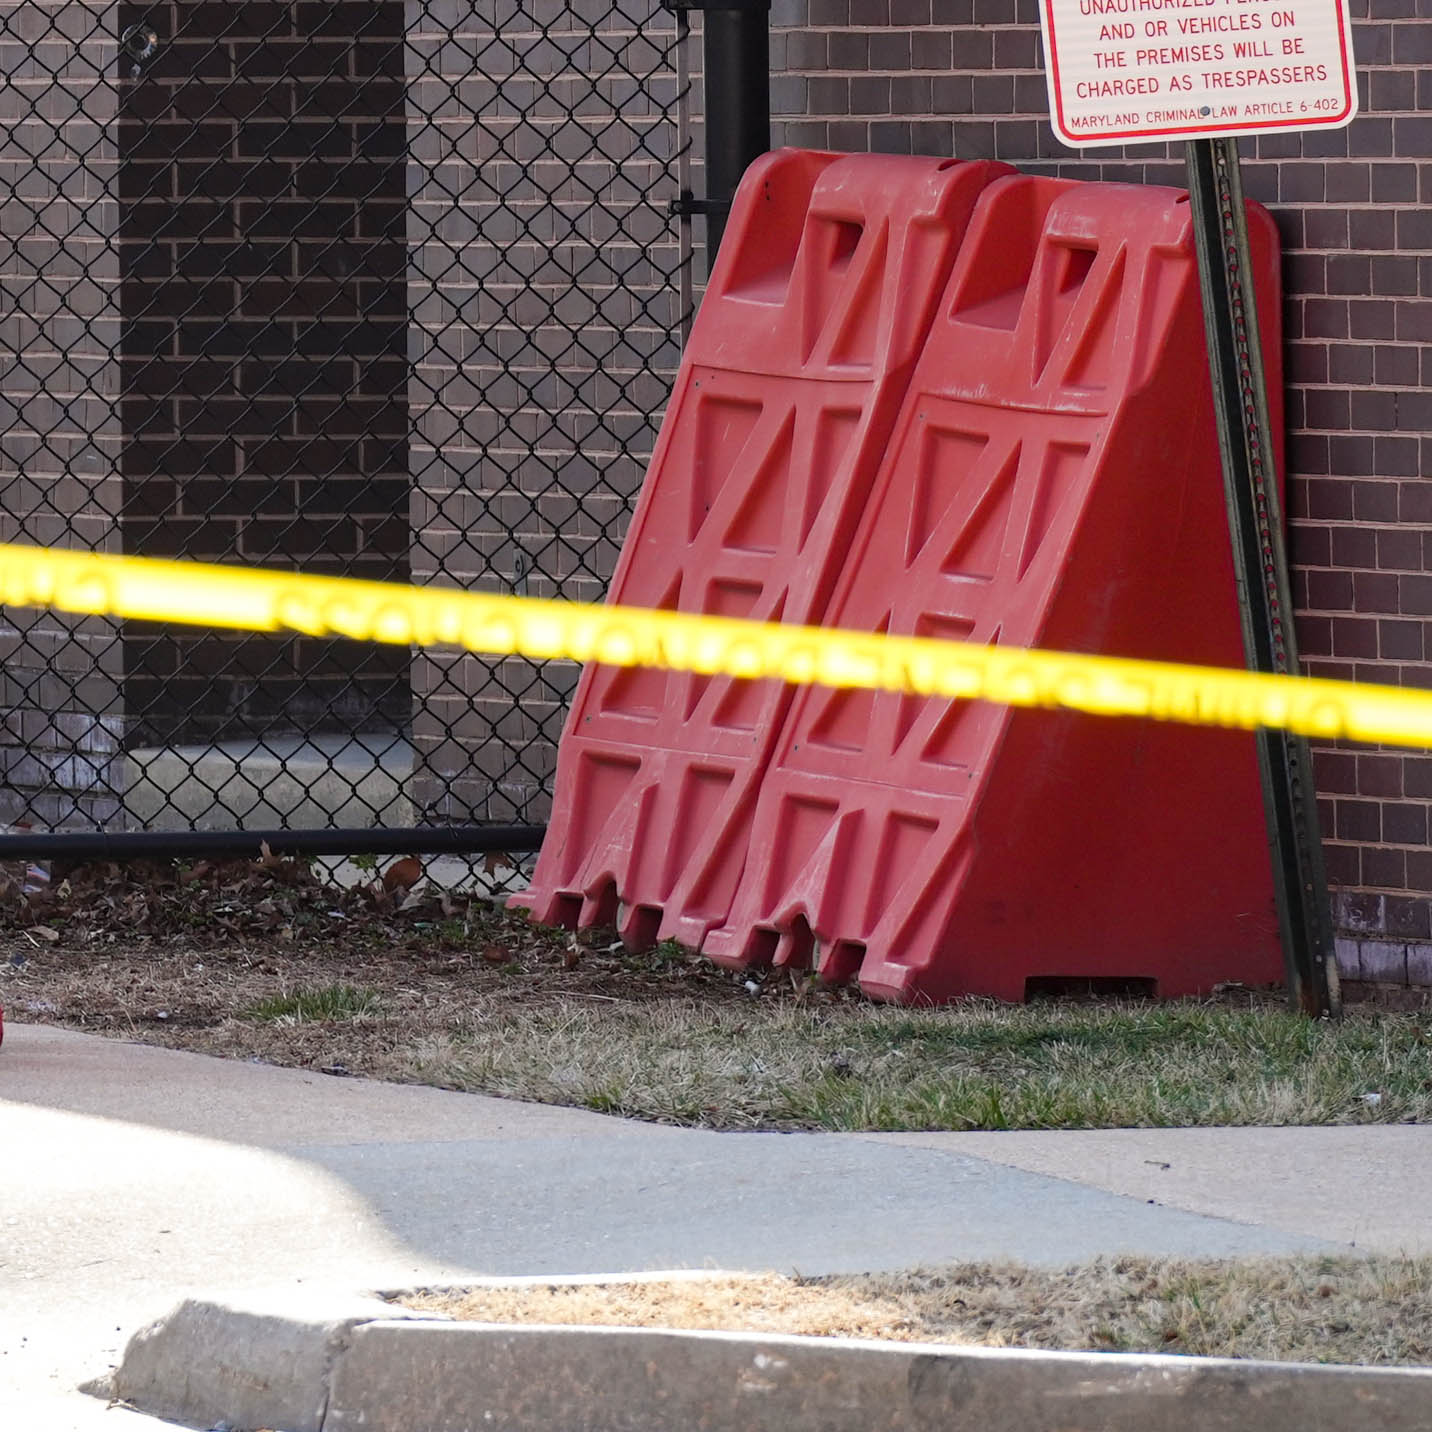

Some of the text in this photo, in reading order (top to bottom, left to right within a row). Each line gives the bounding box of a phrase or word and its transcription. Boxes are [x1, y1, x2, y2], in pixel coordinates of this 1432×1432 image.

[1098, 10, 1296, 41] AND OR VEHICLES ON
[1092, 38, 1306, 70] THE PREMISES WILL BE
[1075, 64, 1329, 100] CHARGED AS TRESPASSERS
[1070, 97, 1340, 129] MARYLAND CRIMINAL LAW ARTICLE 6-402
